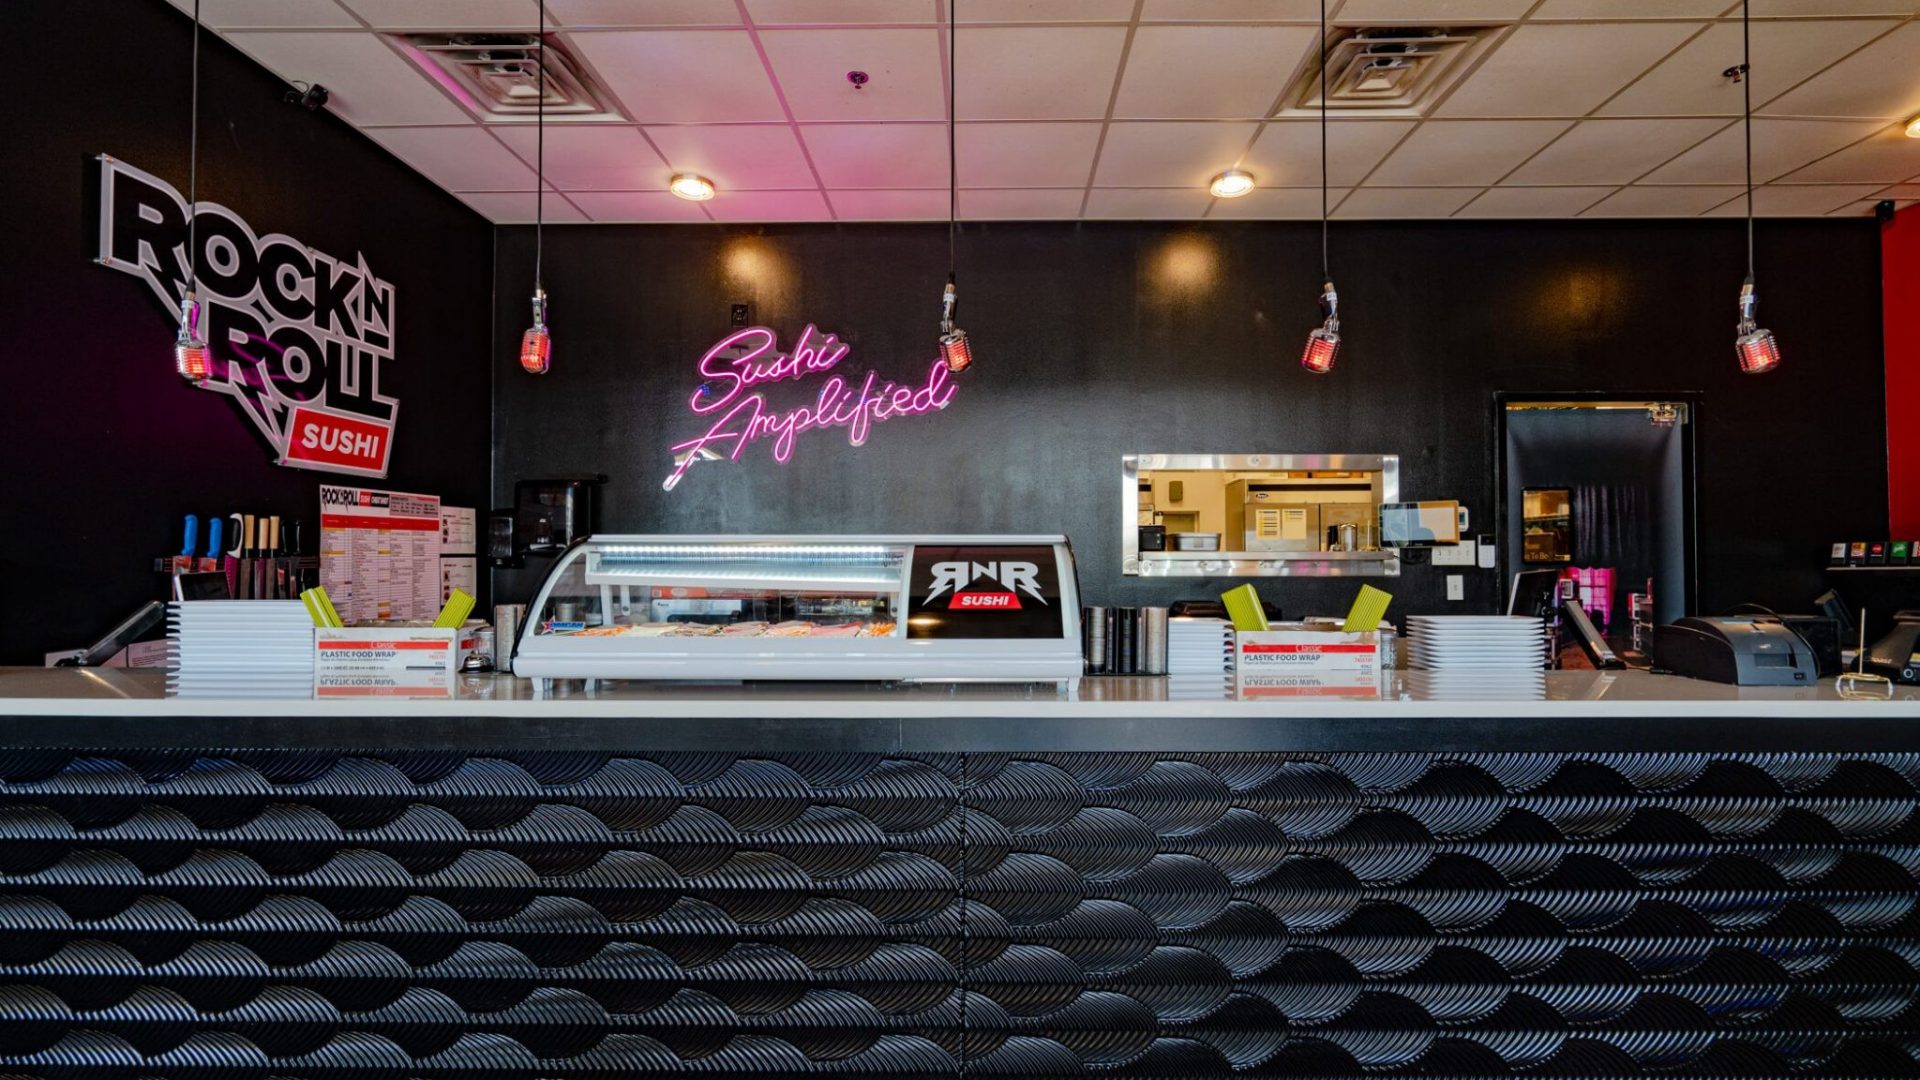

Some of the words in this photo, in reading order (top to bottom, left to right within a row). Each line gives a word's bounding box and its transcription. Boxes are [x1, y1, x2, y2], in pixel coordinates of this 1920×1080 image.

[208, 306, 393, 438] ROLL
[690, 323, 849, 414] Sushi
[301, 422, 380, 459] SUSHI
[663, 360, 958, 491] Amplified
[961, 595, 1009, 606] SUSHI
[1296, 644, 1322, 653] Classic
